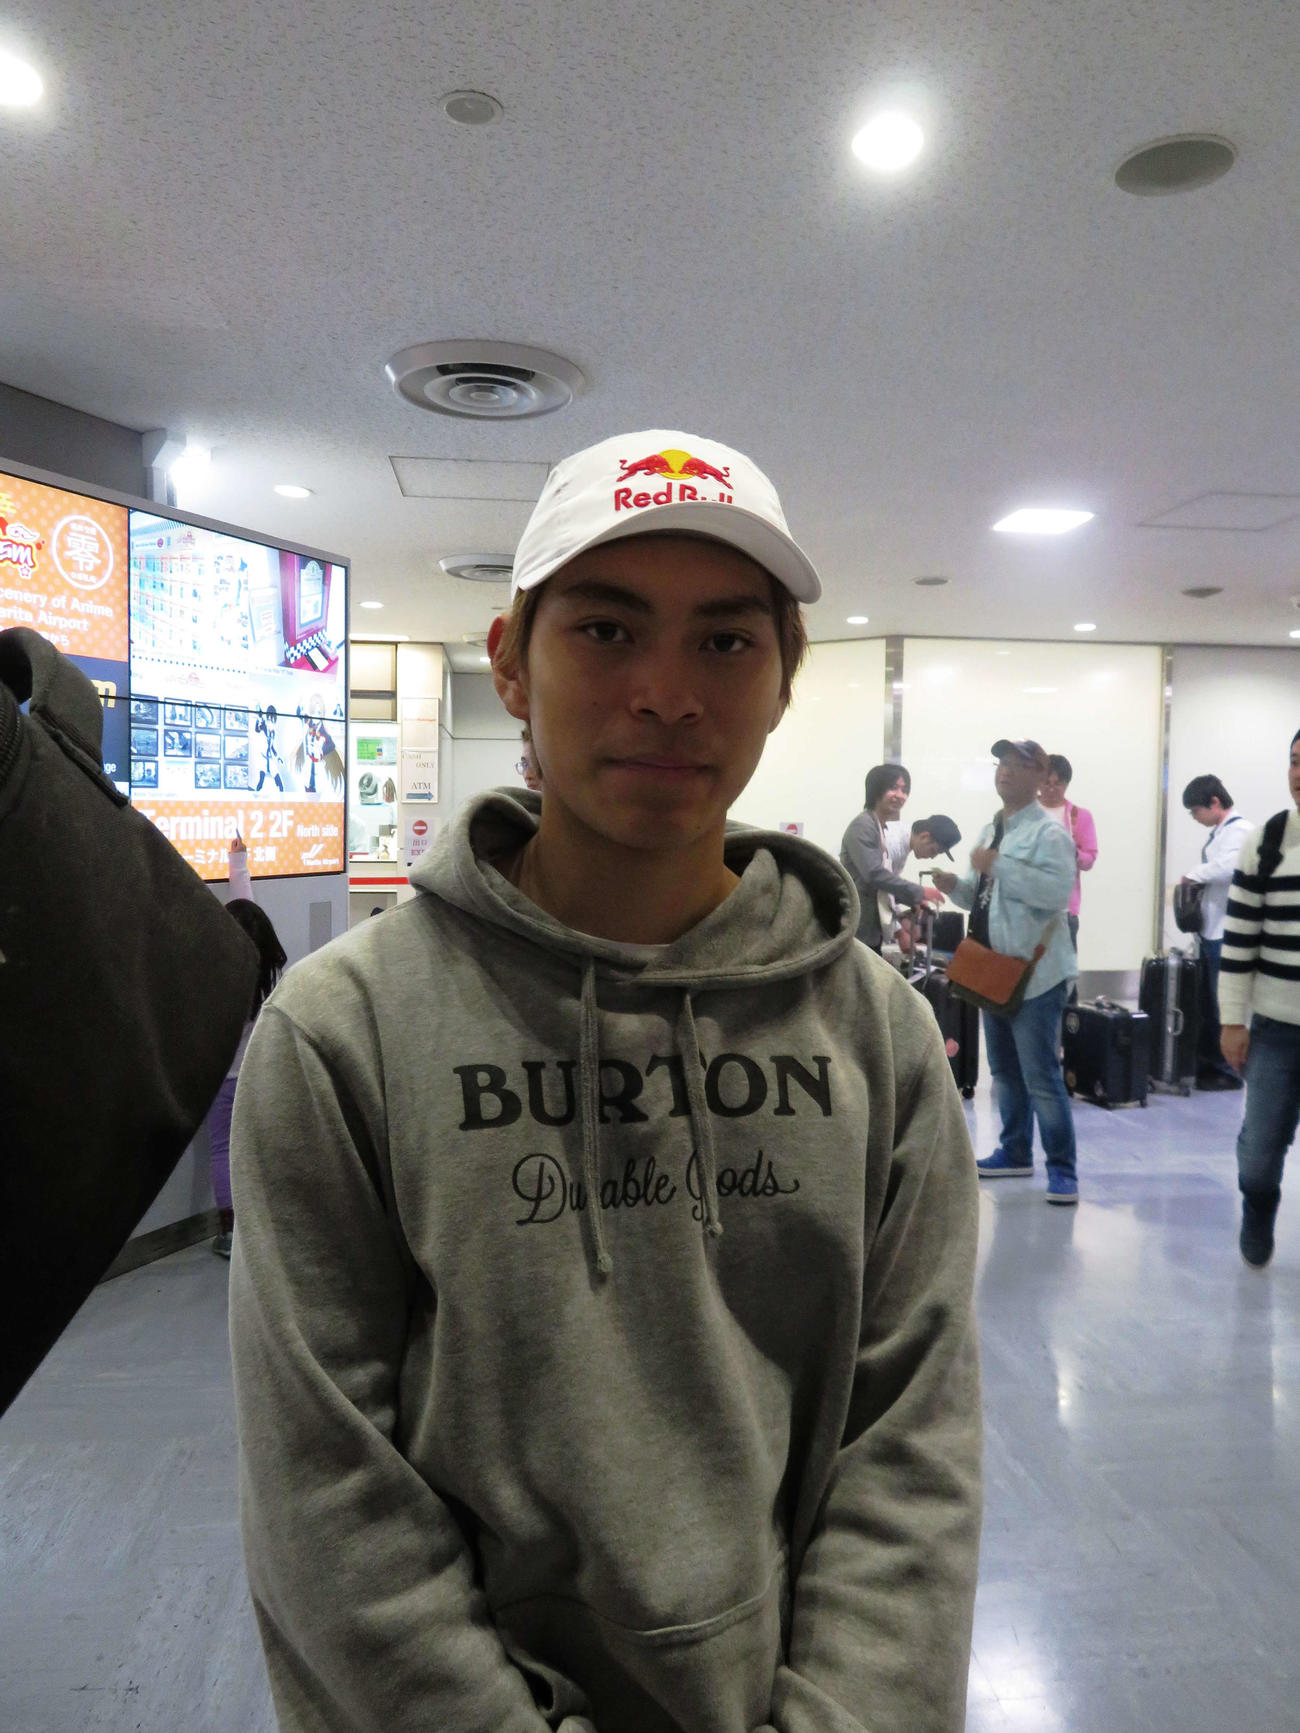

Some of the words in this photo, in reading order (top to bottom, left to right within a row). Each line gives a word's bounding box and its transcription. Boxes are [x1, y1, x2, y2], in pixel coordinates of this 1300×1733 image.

[614, 482, 673, 511] Red
[51, 594, 67, 608] of
[37, 610, 89, 631] Airport
[411, 782, 431, 790] ATM
[249, 810, 265, 838] 2
[268, 809, 295, 838] 2F
[452, 1052, 832, 1131] BURTON
[512, 1152, 677, 1226] Duable
